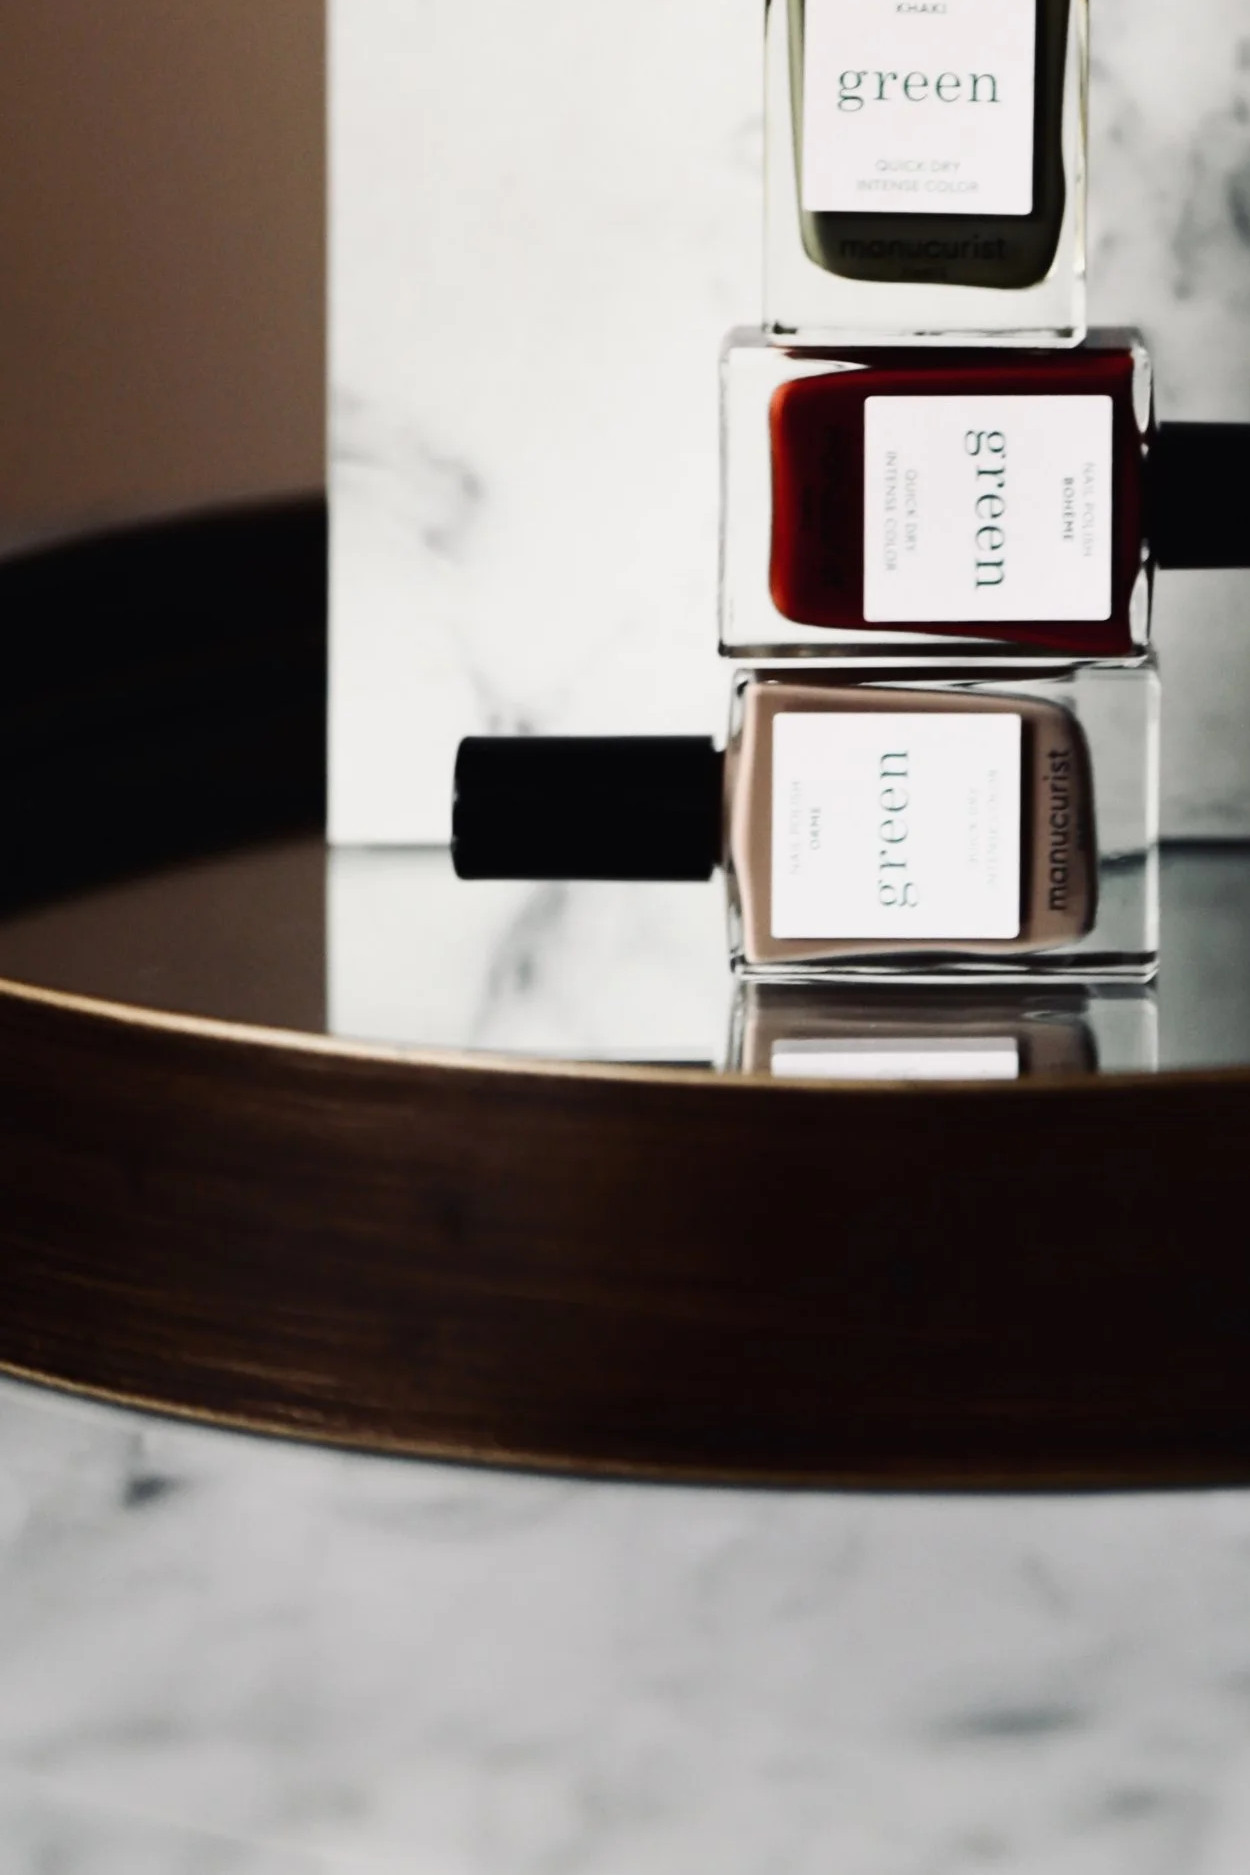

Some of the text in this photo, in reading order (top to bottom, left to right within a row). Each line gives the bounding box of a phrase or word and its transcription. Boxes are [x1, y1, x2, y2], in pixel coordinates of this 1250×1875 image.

[896, 2, 947, 14] KHAKI
[836, 69, 1003, 113] green
[856, 178, 980, 194] INTENSE COLOR
[874, 159, 961, 173] QUICK DRY
[840, 233, 1006, 260] manucurist
[884, 450, 898, 571] INTENSE COLOR
[904, 469, 919, 552] QUICK DRY
[964, 429, 1008, 591] green
[1082, 462, 1097, 558] NAIL POLISH
[876, 749, 920, 909] green
[1040, 750, 1071, 912] manucurist
